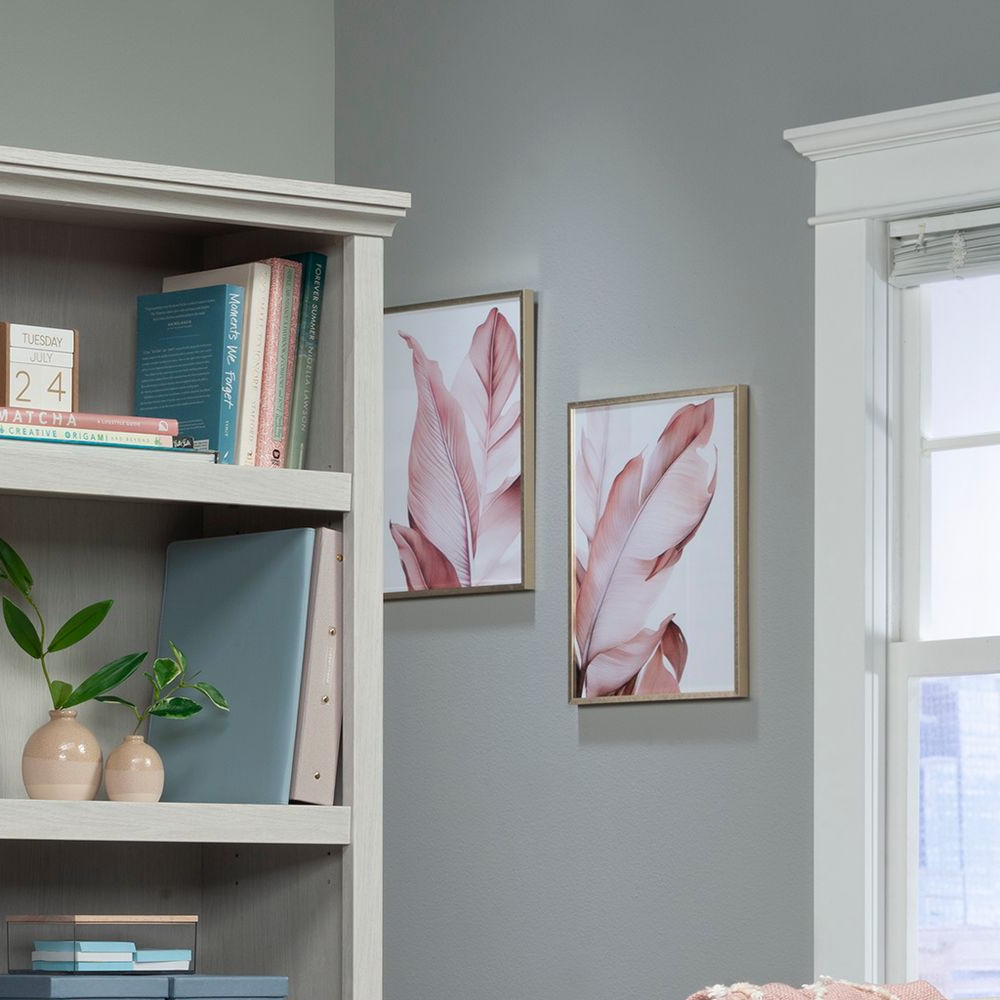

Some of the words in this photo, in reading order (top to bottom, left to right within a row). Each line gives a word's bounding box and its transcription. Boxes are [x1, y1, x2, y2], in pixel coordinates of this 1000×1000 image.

[312, 263, 322, 301] FOREVER
[228, 292, 241, 341] Moments
[308, 303, 318, 340] SUMMER
[22, 332, 64, 347] TUESDAY
[29, 351, 53, 363] JULY
[226, 345, 238, 365] We
[221, 370, 236, 409] Forget
[301, 389, 311, 431] LAWSON
[8, 426, 57, 438] CREATIVE
[64, 430, 108, 441] ORIGAMI
